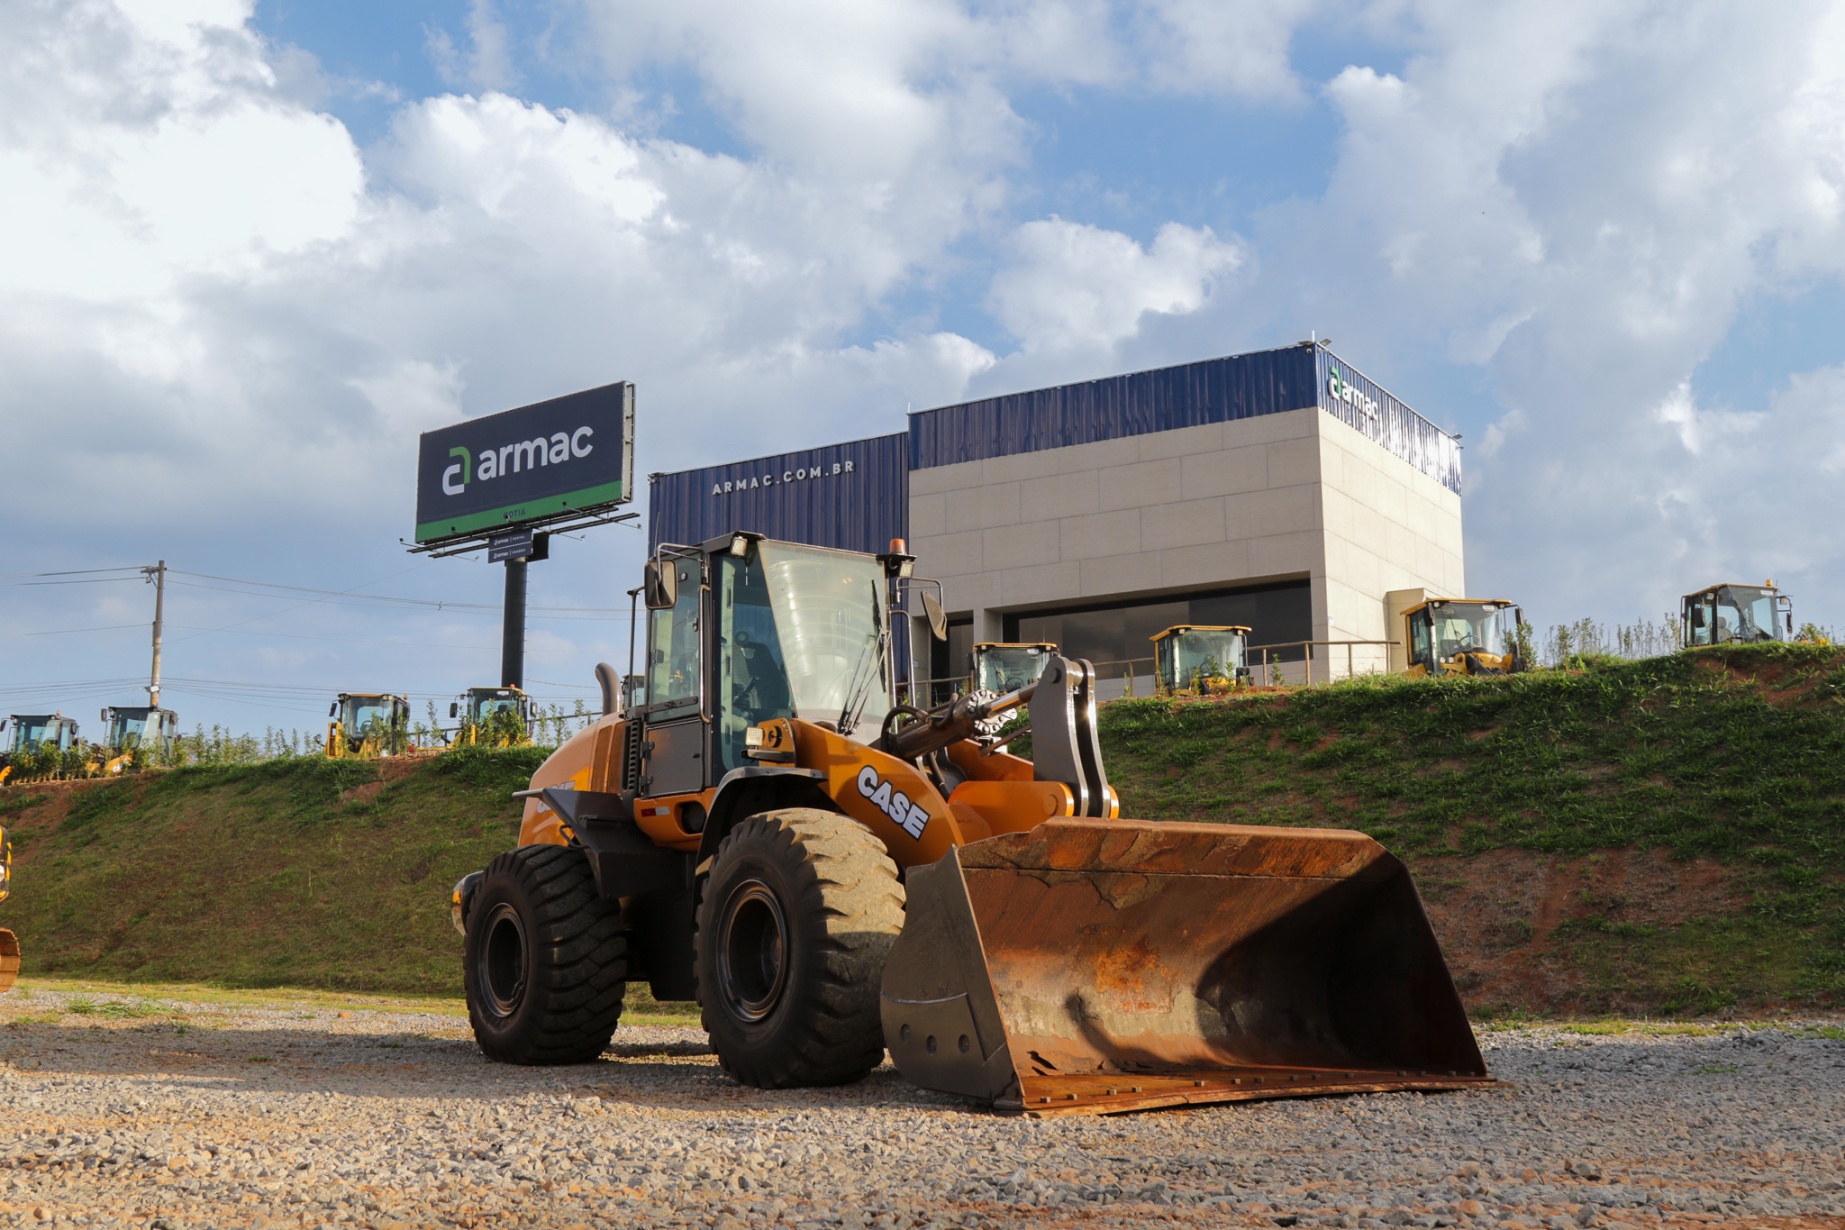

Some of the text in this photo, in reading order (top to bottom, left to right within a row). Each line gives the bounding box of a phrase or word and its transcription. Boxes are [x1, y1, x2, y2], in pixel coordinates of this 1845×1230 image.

[1341, 380, 1378, 420] armac
[477, 426, 594, 481] armac
[712, 461, 855, 495] ARMAC.COM.BR
[857, 765, 931, 841] CASE
